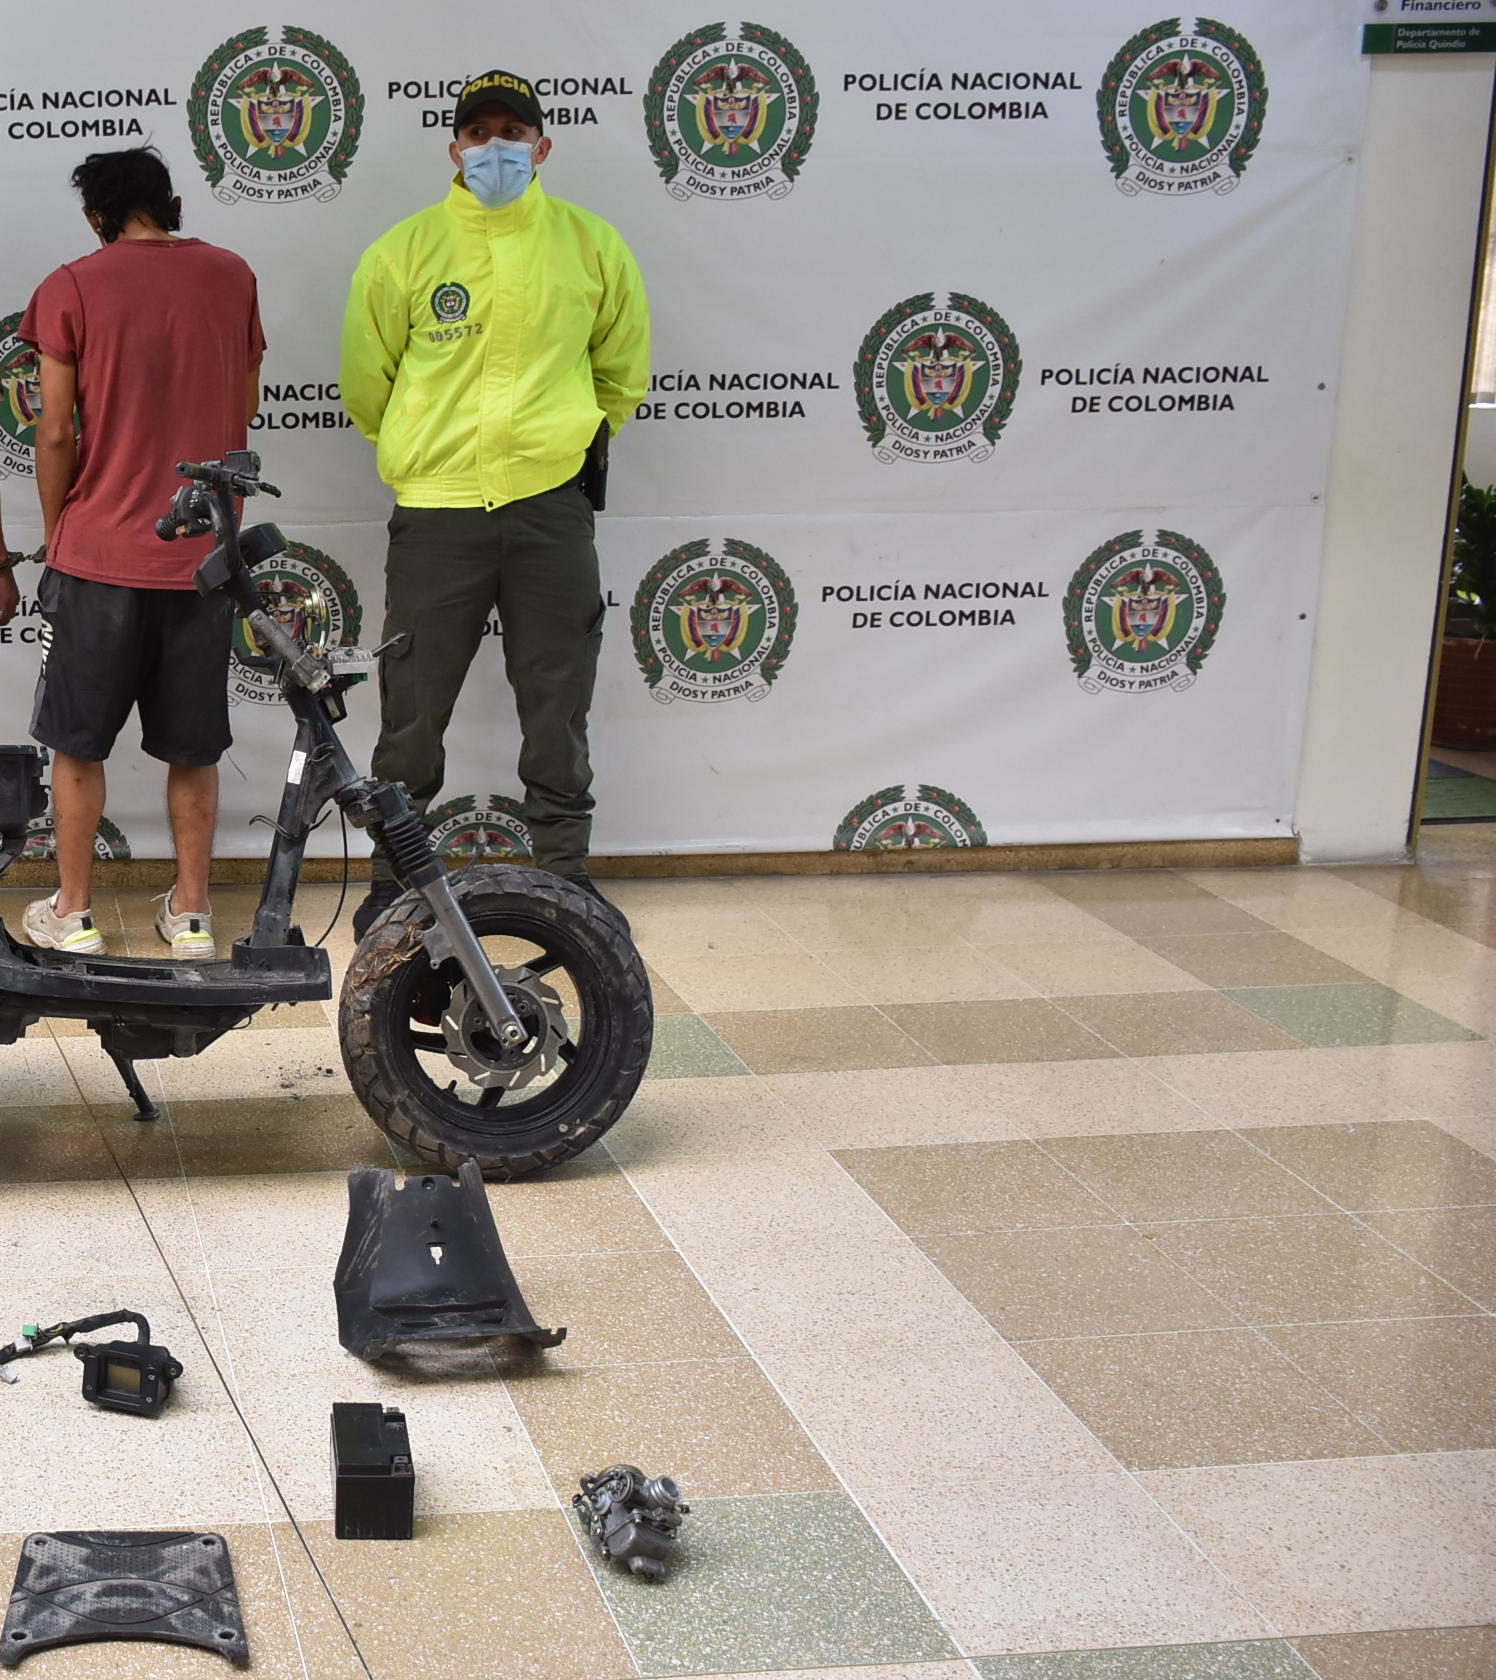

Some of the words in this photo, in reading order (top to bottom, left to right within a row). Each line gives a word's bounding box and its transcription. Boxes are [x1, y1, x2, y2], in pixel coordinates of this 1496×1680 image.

[1397, 28, 1467, 38] Departamento
[268, 46, 287, 56] DE
[301, 54, 342, 123] COLOMBIA
[387, 75, 471, 100] POLIC
[535, 77, 633, 96] CIONAL
[461, 73, 531, 102] POLICIA
[726, 43, 744, 52] DE
[759, 51, 796, 120] COLOMBIA
[843, 68, 944, 92] POLICÍA
[951, 72, 1083, 91] NACIONAL
[1179, 38, 1198, 48] DE
[1212, 46, 1245, 116] COLOMBIA
[42, 88, 177, 109] NACIONAL
[422, 110, 454, 128] DE
[541, 107, 599, 126] MBIA
[876, 102, 908, 121] DE
[915, 101, 1049, 120] COLOMBIA
[7, 118, 143, 140] COLOMBIA
[278, 139, 336, 182] NACIONAL
[731, 137, 791, 179] NACIONAL
[1180, 133, 1239, 174] NACIONAL
[278, 178, 322, 199] PATRIA
[730, 176, 775, 196] PATRIA
[1178, 171, 1222, 192] PATRIA
[934, 312, 952, 322] DE
[965, 320, 1001, 387] COLOMBIA
[709, 372, 840, 390] NACIONAL
[1040, 363, 1135, 386] POLICÍA
[1142, 366, 1269, 384] NACIONAL
[263, 383, 341, 402] NACIO
[1071, 396, 1101, 413] DE
[1107, 394, 1235, 412] COLOMBIA
[635, 402, 666, 420] DE
[674, 401, 806, 419] COLOMBIA
[934, 402, 993, 443] NACIONAL
[933, 440, 977, 459] PATRIA
[3, 456, 33, 475] DIOS
[709, 557, 728, 567] DE
[740, 565, 777, 630] COLOMBIA
[822, 579, 916, 602] POLICÍA
[924, 581, 1050, 600] NACIONAL
[1141, 548, 1160, 558] DE
[1172, 555, 1205, 619] COLOMBIA
[269, 560, 288, 570] DE
[301, 566, 341, 633] COLOMBIA
[852, 612, 882, 629] DE
[889, 609, 1016, 627] COLOMBIA
[712, 644, 770, 684] NACIONAL
[1140, 635, 1199, 674] NACIONAL
[711, 680, 754, 699] PATRIA
[1138, 670, 1180, 689] PATRIA
[475, 812, 493, 821] DE
[904, 802, 922, 812] DE
